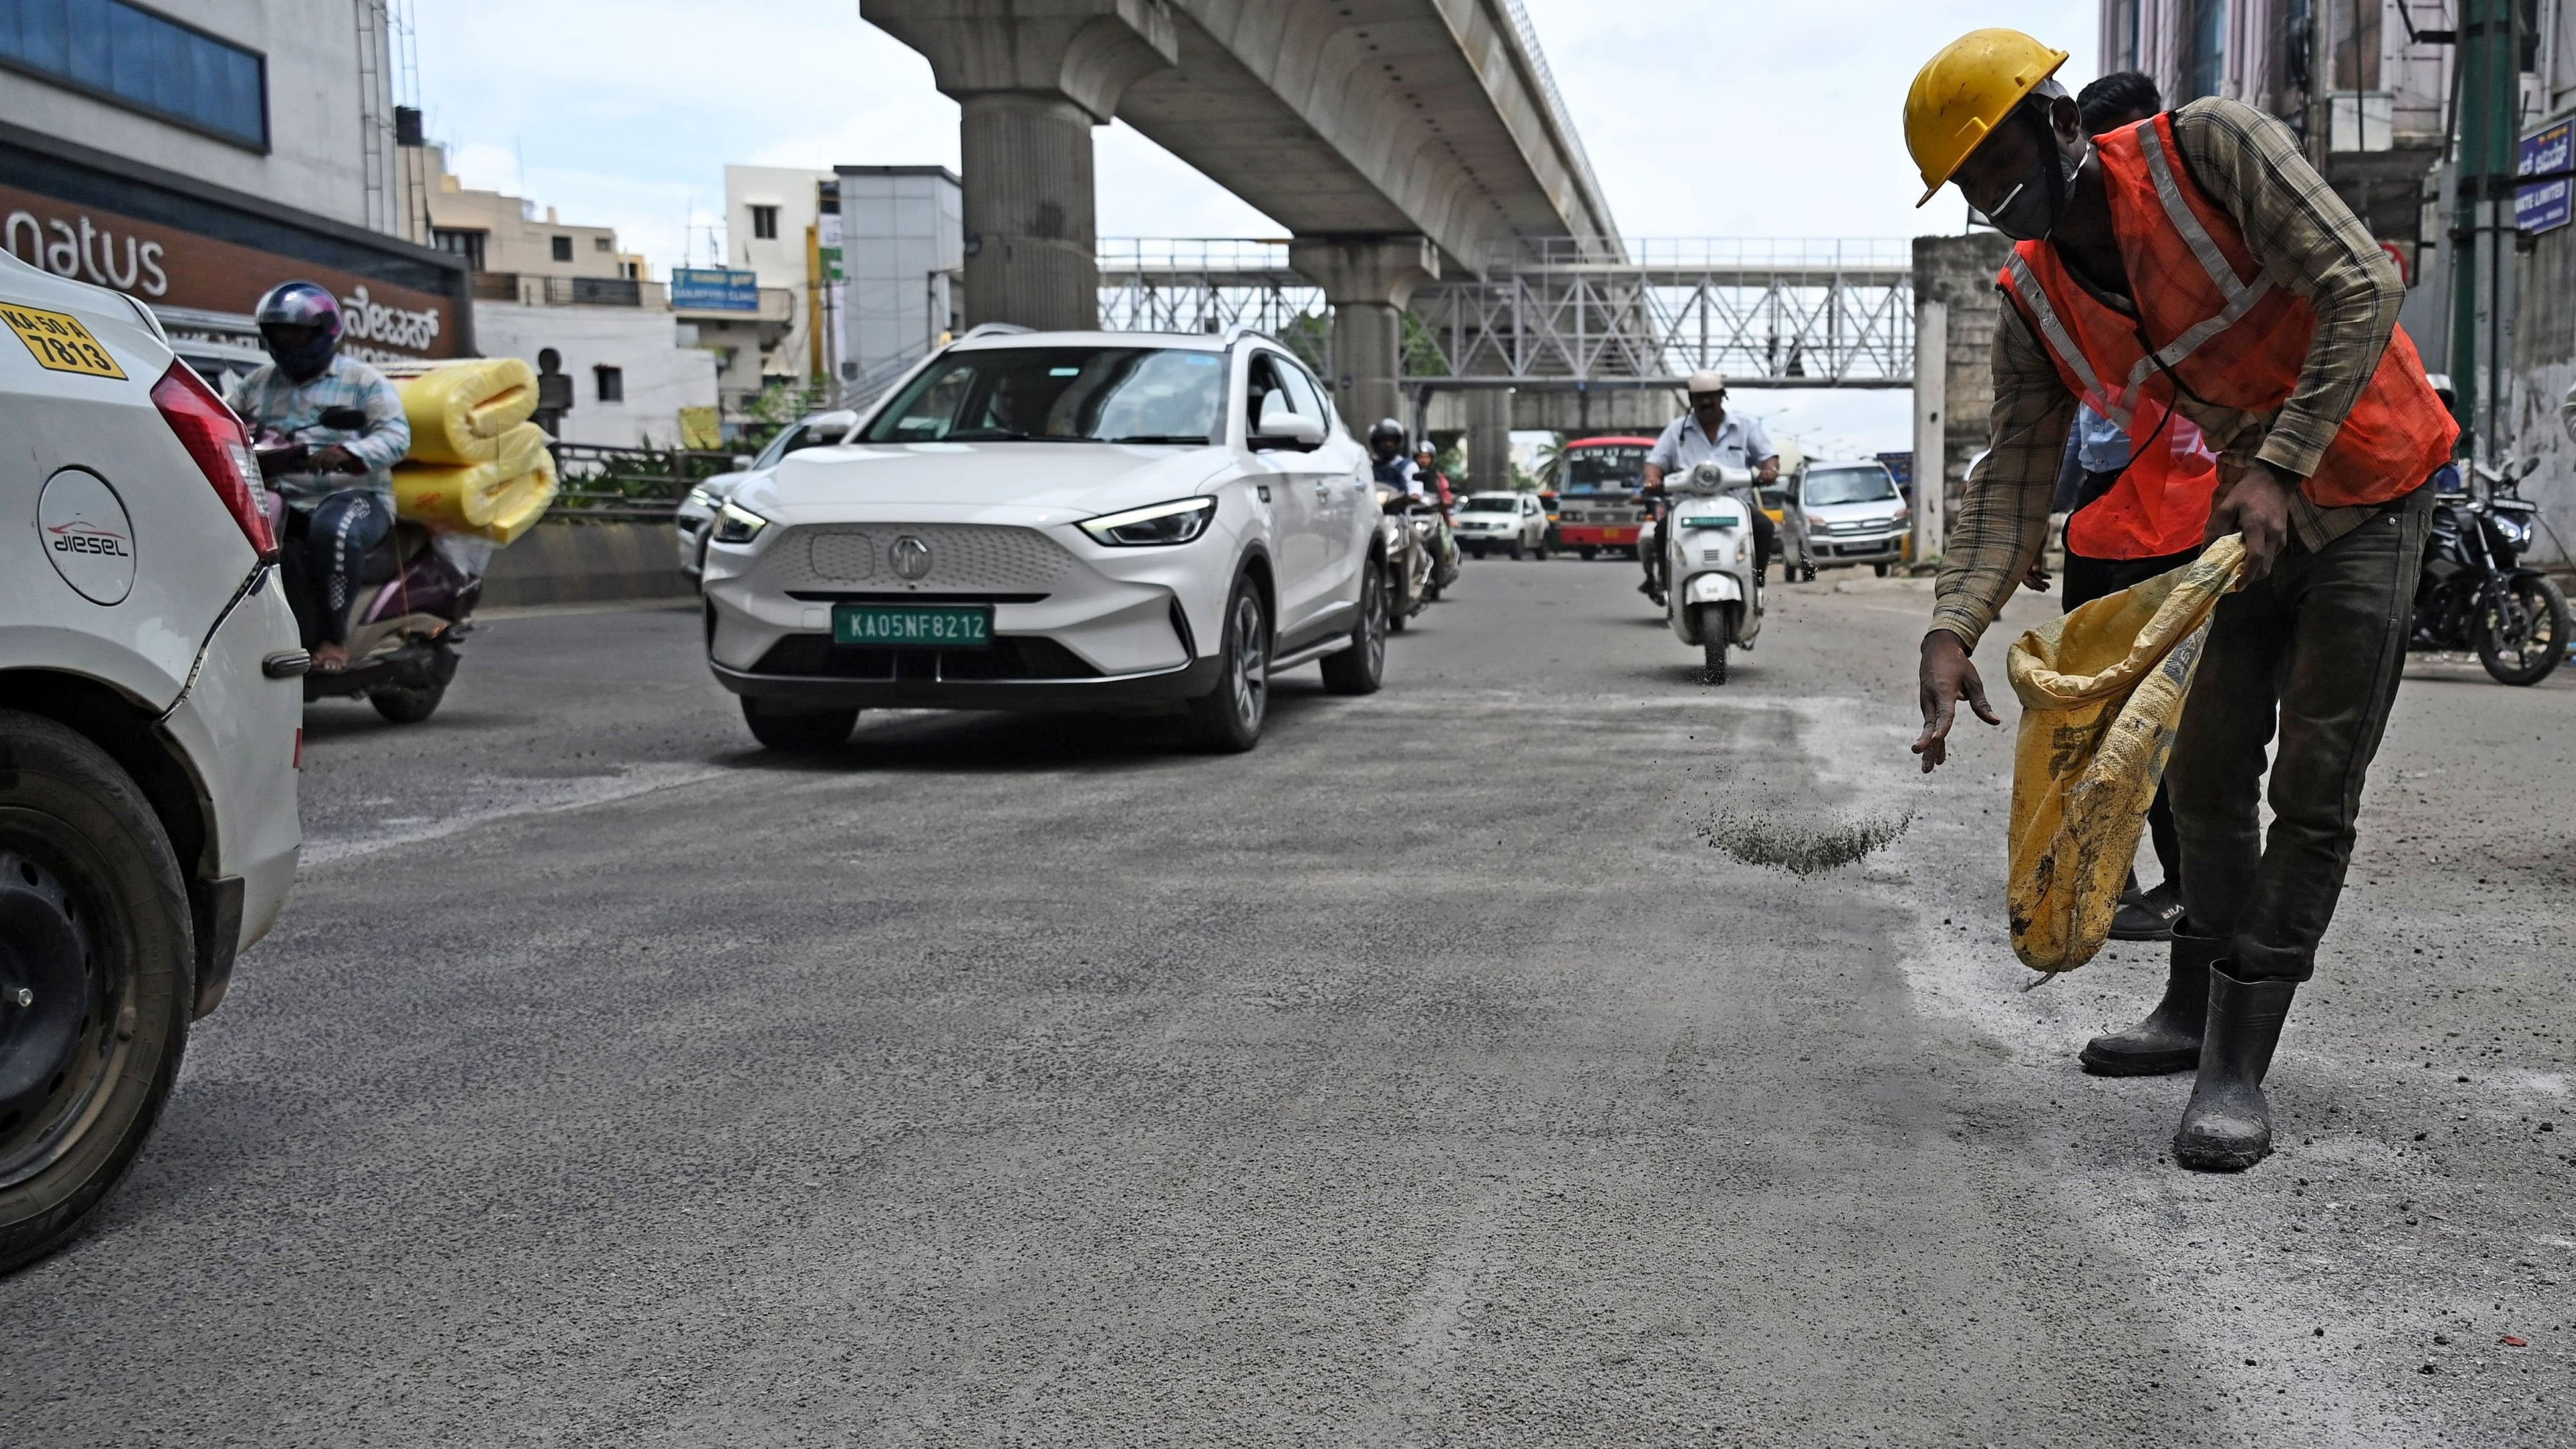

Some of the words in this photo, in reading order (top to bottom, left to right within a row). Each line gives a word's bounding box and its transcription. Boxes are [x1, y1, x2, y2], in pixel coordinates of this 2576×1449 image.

[5, 211, 168, 297] natus
[27, 334, 111, 370] 7813
[850, 614, 985, 638] KA05NF8212
